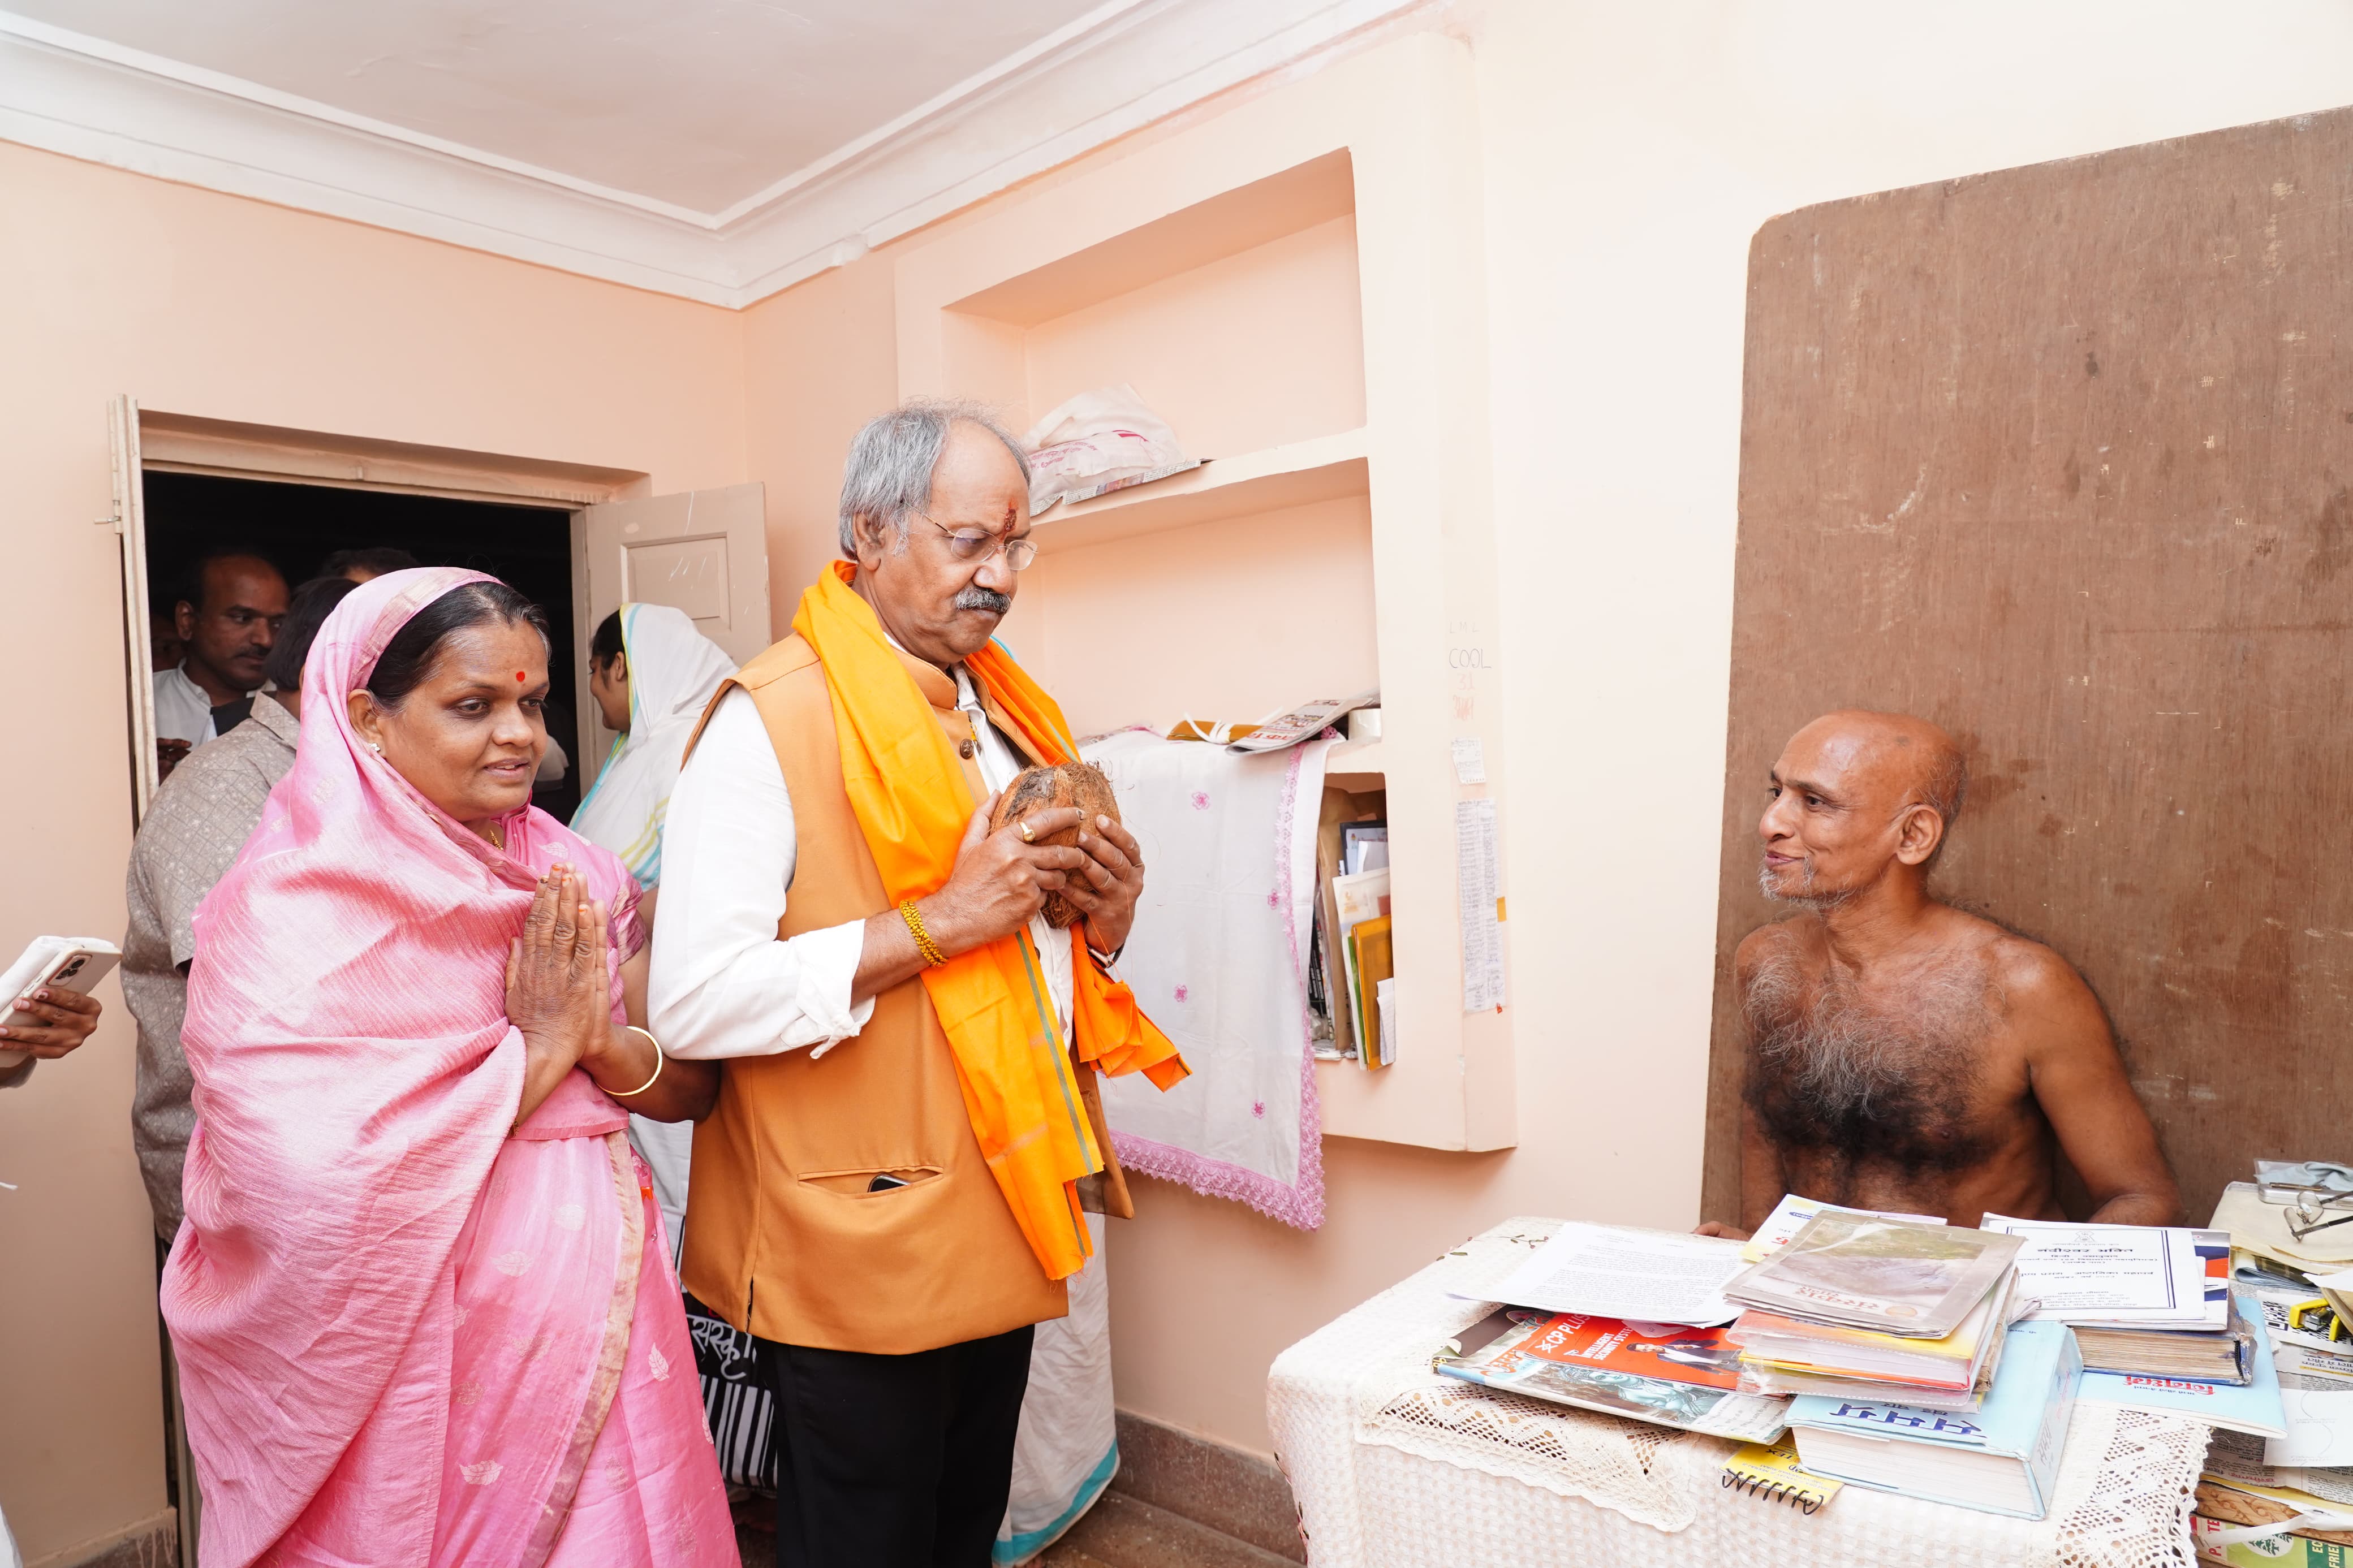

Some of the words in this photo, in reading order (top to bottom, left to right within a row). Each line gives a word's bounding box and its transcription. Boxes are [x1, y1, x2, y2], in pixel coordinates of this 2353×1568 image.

[1449, 648, 1492, 669] COOL
[1546, 1331, 1567, 1345] CP
[1557, 1314, 1590, 1334] PLUS
[1580, 1332, 1615, 1358] INTELLIGENT
[1592, 1341, 1621, 1360] SECURITY
[1613, 1327, 1634, 1342] SYSTE
[1829, 1403, 1987, 1439] समय
